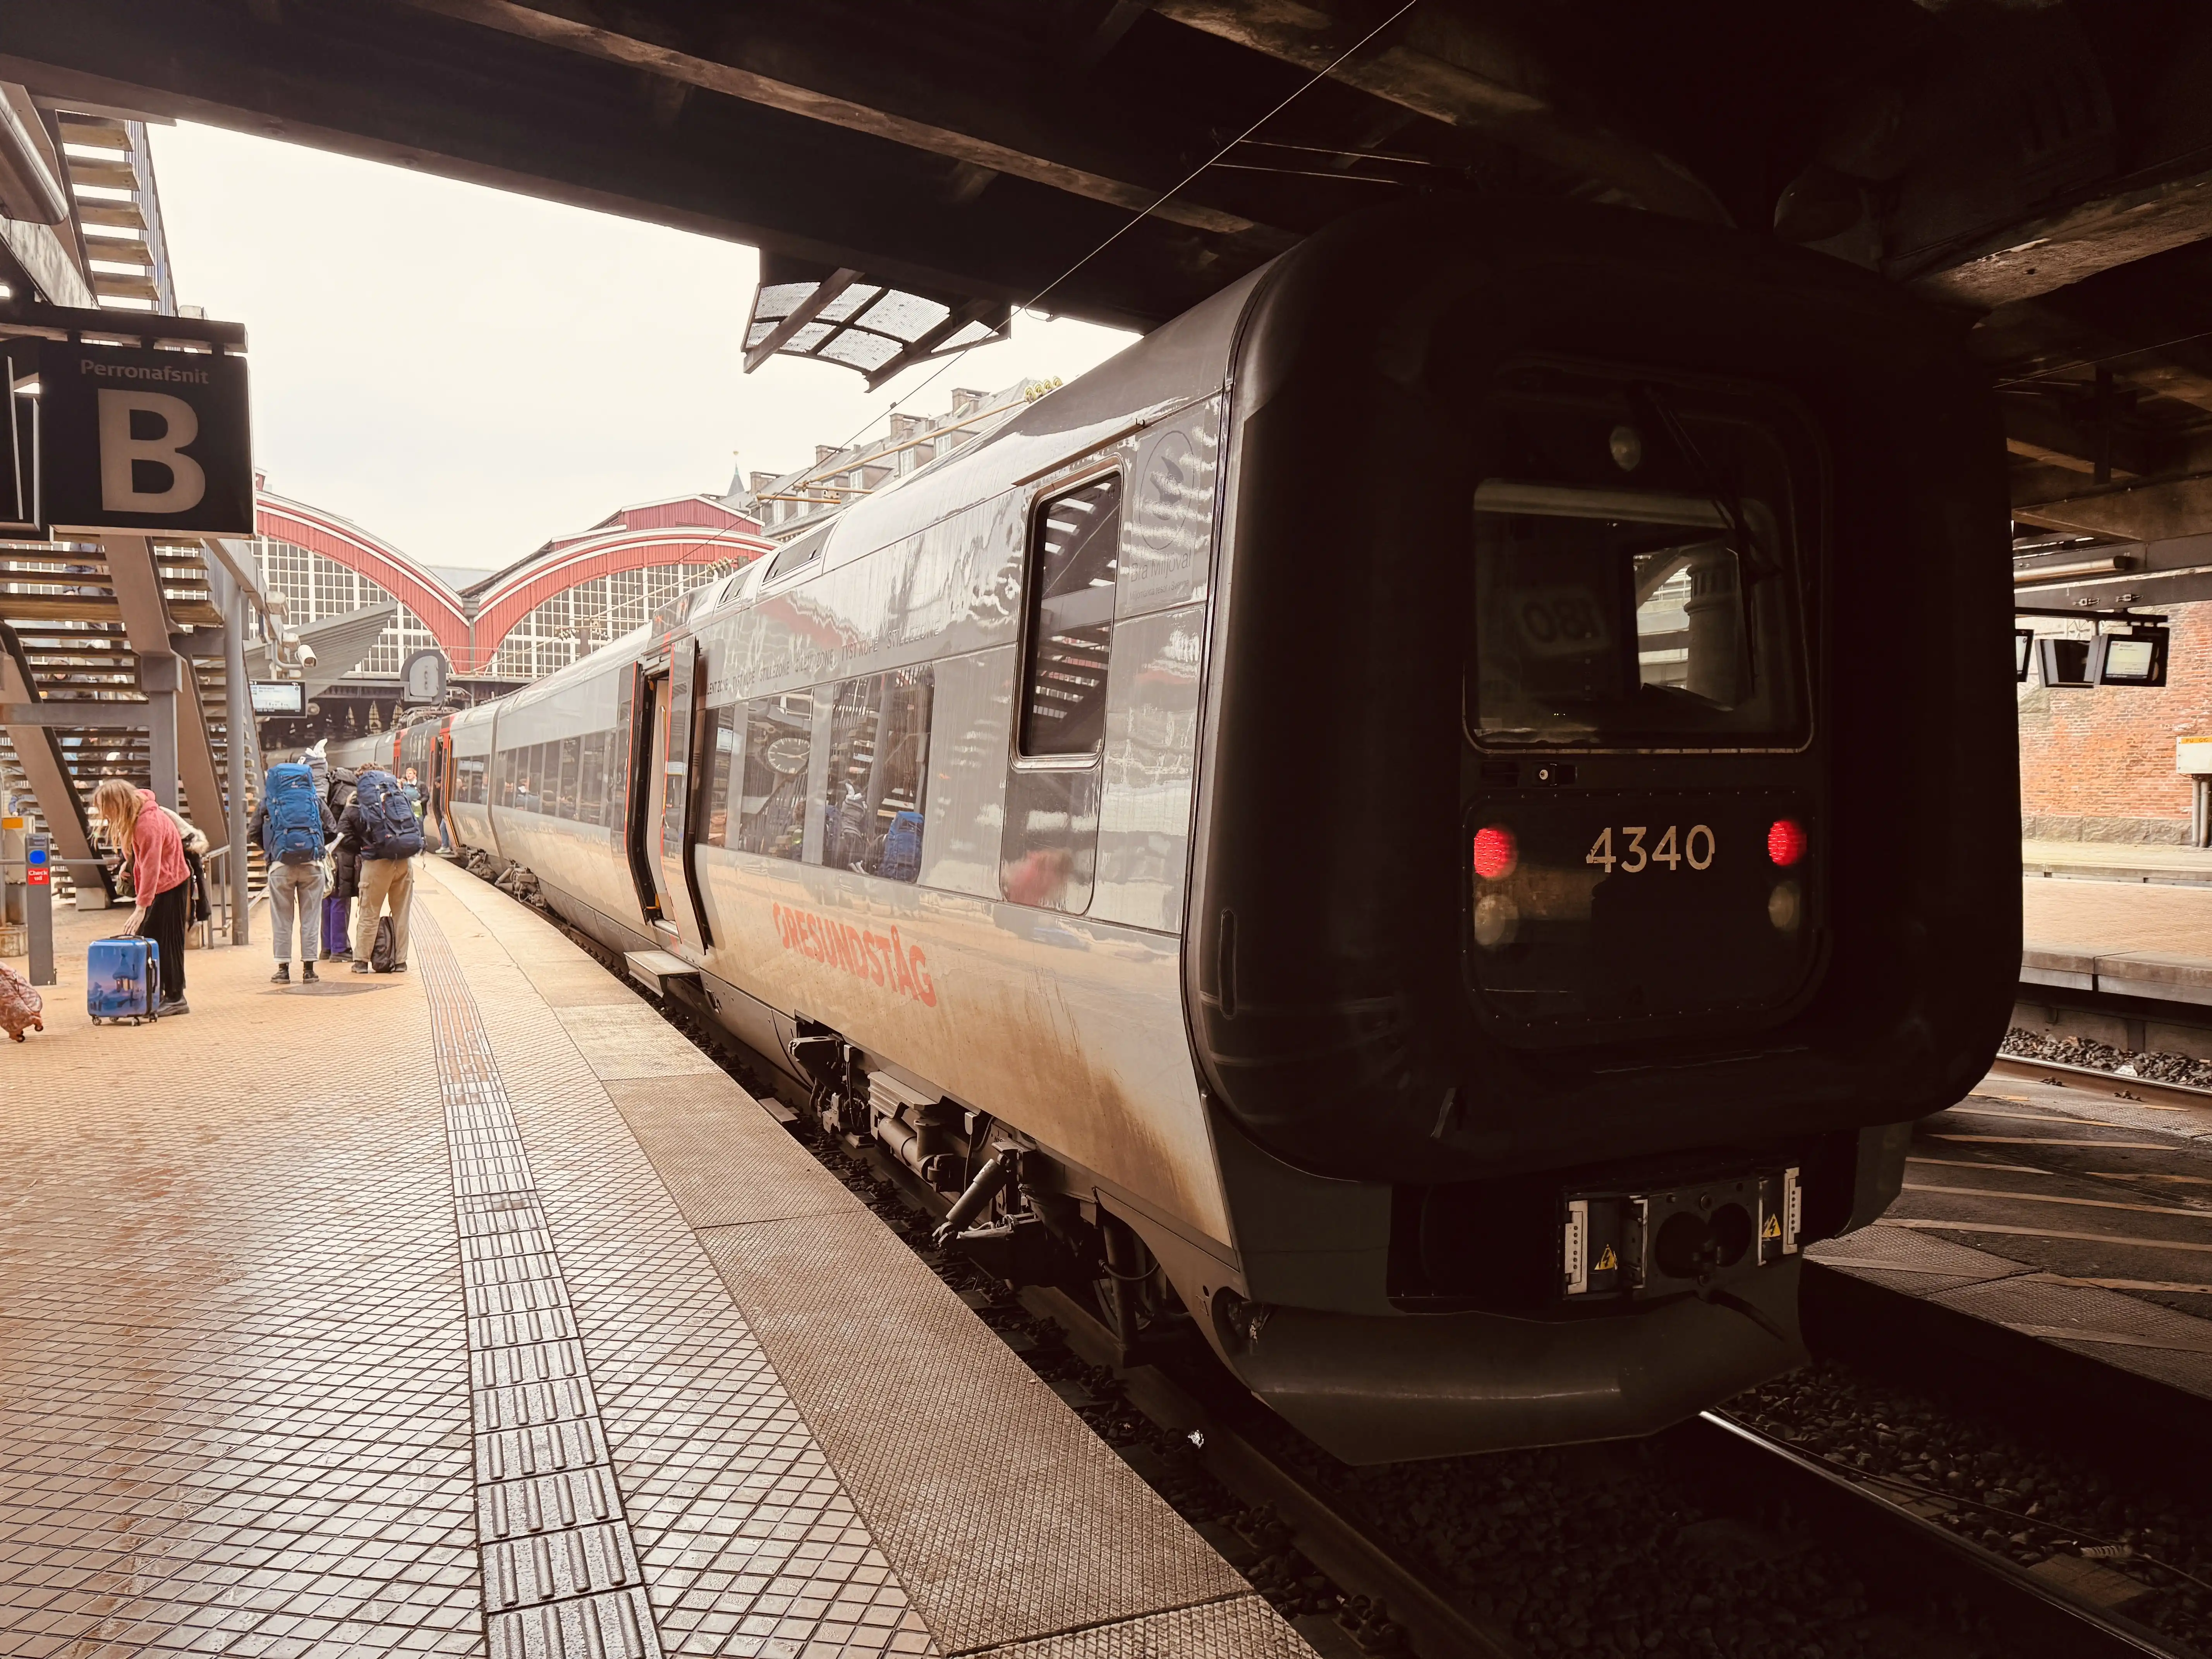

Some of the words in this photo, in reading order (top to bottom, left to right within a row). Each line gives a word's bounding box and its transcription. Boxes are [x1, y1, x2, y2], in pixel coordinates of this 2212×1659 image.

[80, 359, 210, 385] Perronafsnit
[97, 388, 206, 514] B
[1131, 562, 1147, 582] Bra
[1151, 547, 1191, 579] Miljöval
[817, 647, 834, 666] ZONE
[841, 642, 857, 661] TYST
[886, 619, 940, 649] STILLEZONE
[1586, 824, 1716, 874] 4340
[773, 902, 937, 1007] ØRESUNDSTÅG
